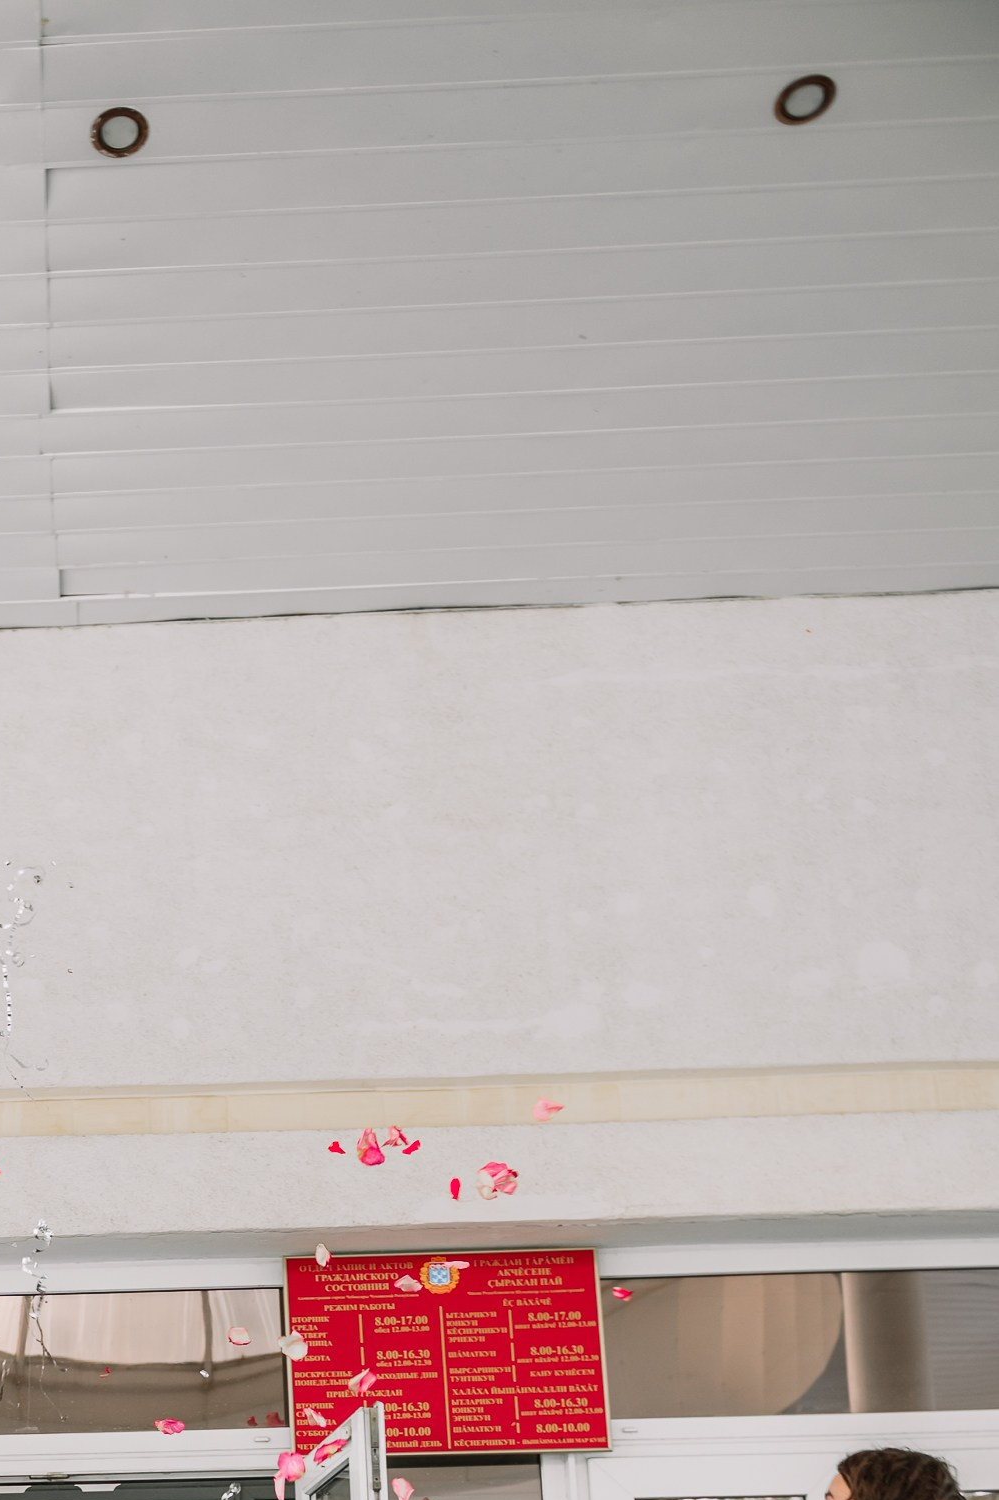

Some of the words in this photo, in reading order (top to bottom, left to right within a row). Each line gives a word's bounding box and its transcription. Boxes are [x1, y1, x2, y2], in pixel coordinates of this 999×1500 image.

[299, 1264, 333, 1273] ОТДЕЛ
[336, 1263, 377, 1271] ЗАПИСИ
[379, 1262, 414, 1270] АКТОВ
[315, 1273, 399, 1283] ГРАЖДАНСКОГО
[540, 1275, 563, 1286] ПАЙ
[325, 1283, 389, 1292] СОСТОЯНИЯ
[324, 1304, 357, 1312] РЕЖИМ
[375, 1315, 428, 1326] 8.00-17.00
[528, 1311, 581, 1321] 8.00-17.00
[292, 1324, 318, 1332] СРЕДА
[558, 1320, 596, 1328] 12.00-13.00
[377, 1349, 430, 1359] 8.00-16.30
[530, 1345, 584, 1355] 8.00-16.30
[561, 1354, 599, 1362] 12.00-12.30
[294, 1370, 353, 1378] ВОСКРЕСЕНЬЕ
[294, 1379, 349, 1387] ПОНЕДЕЛЬНИ
[326, 1389, 359, 1398] ПРИЁМ
[384, 1402, 430, 1412] .00-16.30
[534, 1397, 588, 1408] 8.00-16.30
[565, 1407, 603, 1415] 12.00-13.00
[385, 1427, 431, 1437] .00-10.00
[536, 1422, 590, 1433] 8.00-10.00
[420, 1440, 443, 1448] ДЕНЬ
